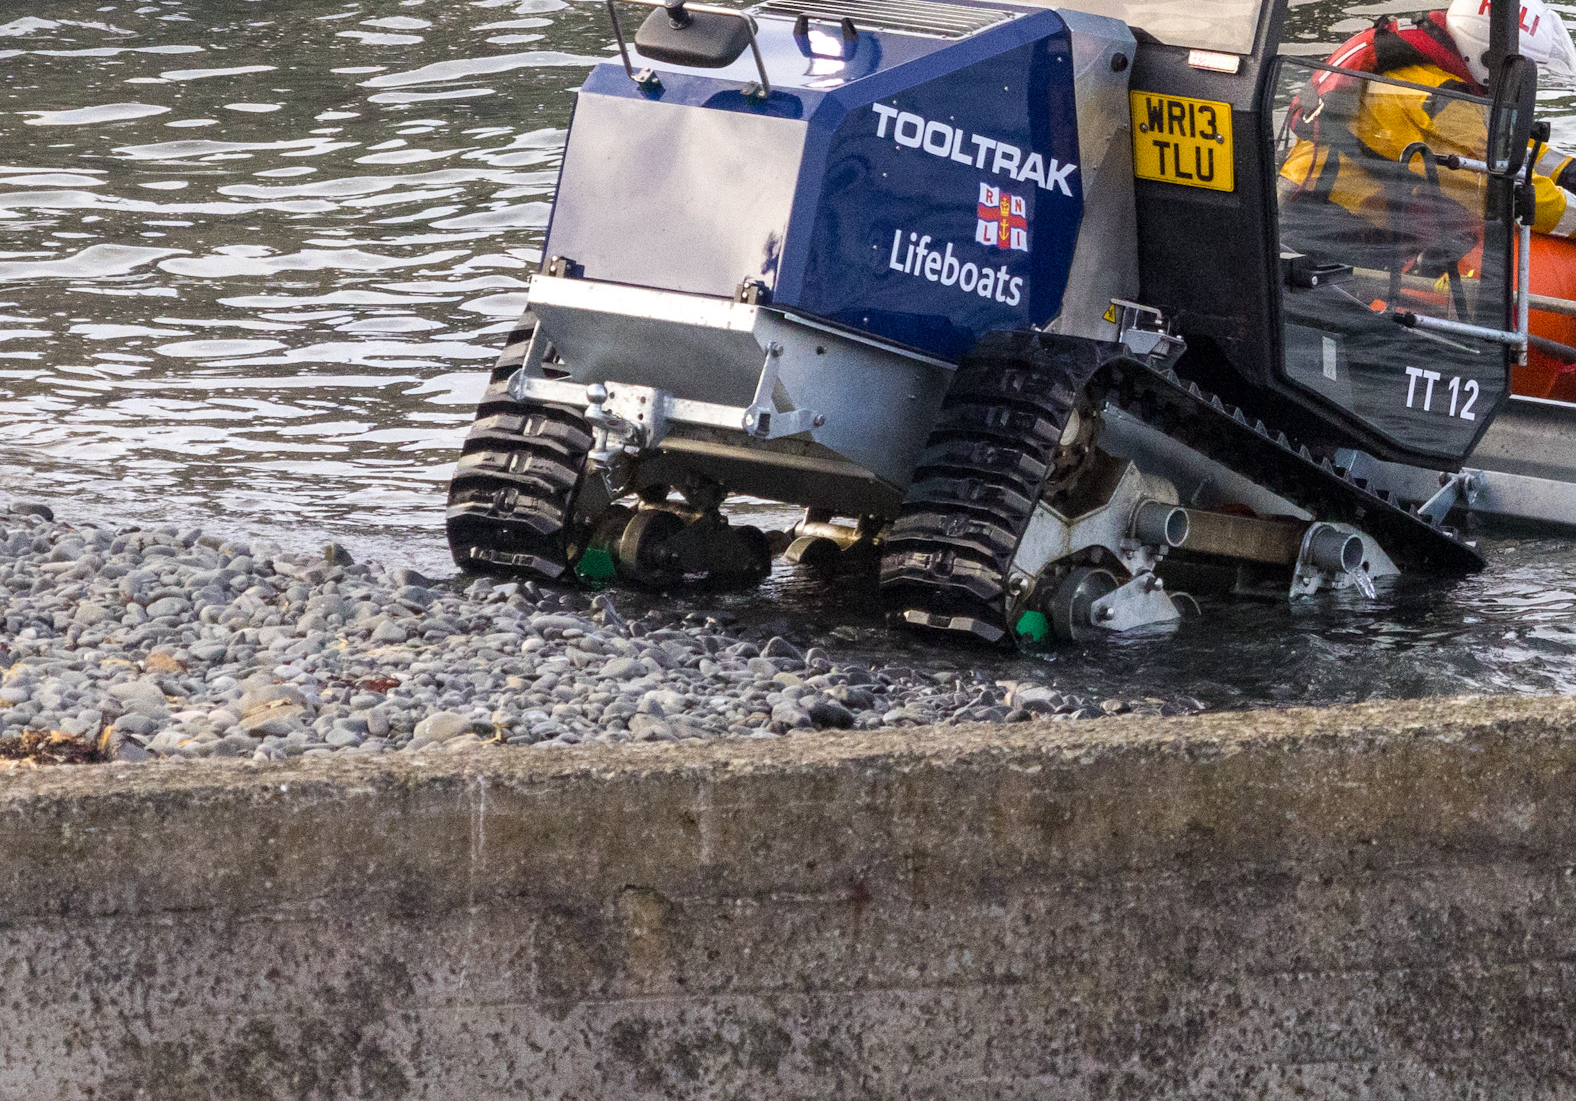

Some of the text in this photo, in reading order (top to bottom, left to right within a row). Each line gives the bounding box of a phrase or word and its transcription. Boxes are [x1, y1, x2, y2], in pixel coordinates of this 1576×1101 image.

[1146, 97, 1217, 140] WR13
[872, 102, 1077, 197] TOOLTRAK
[1152, 140, 1214, 182] TLU
[889, 229, 1024, 306] Lifeboats
[1405, 366, 1479, 421] TT 12
